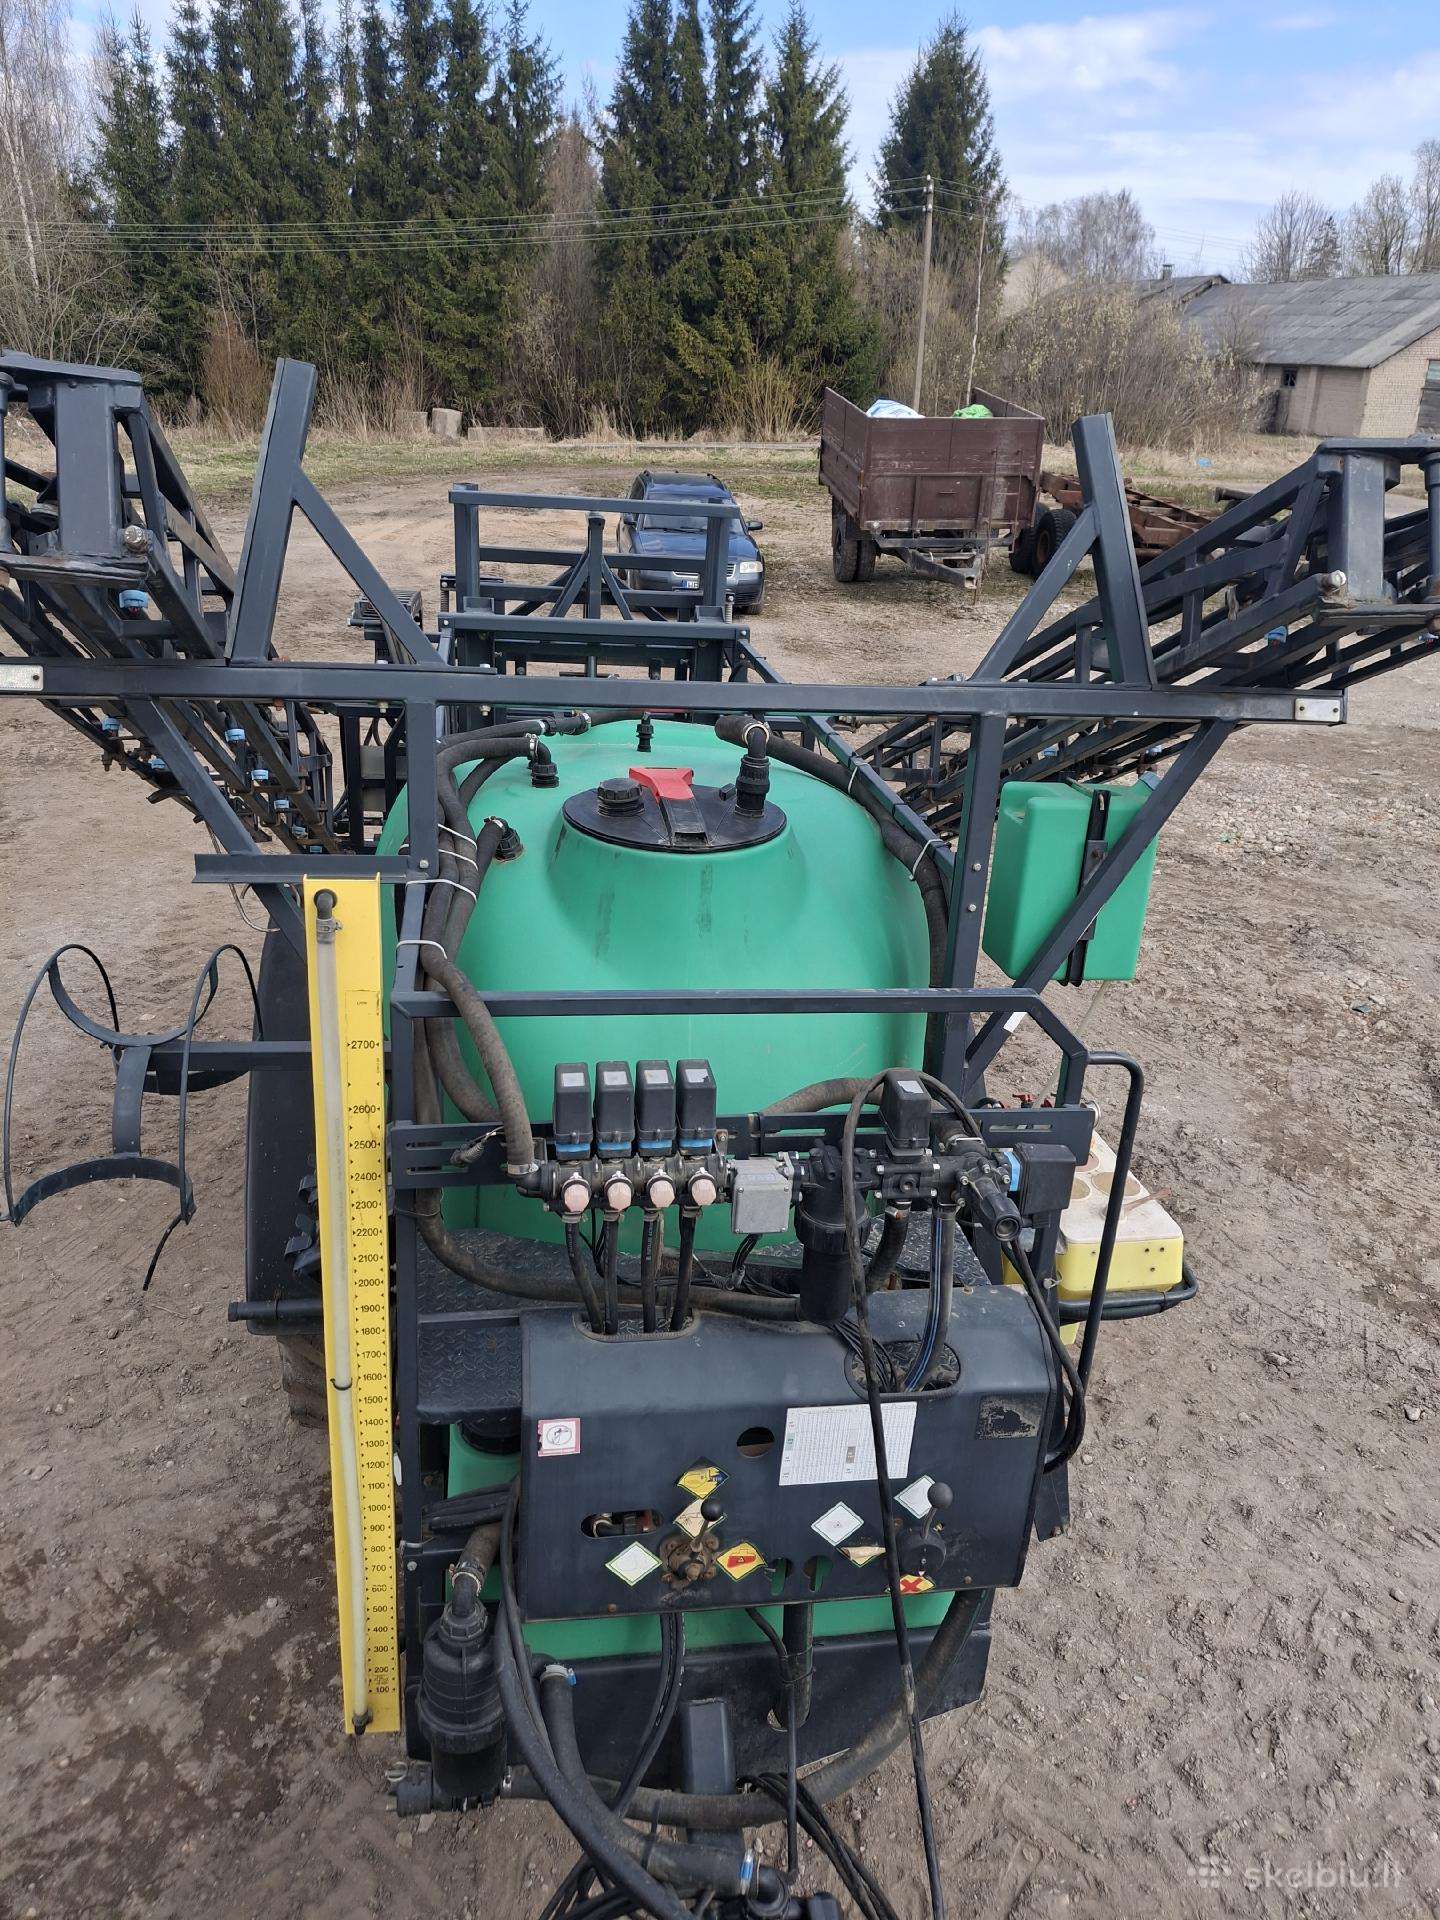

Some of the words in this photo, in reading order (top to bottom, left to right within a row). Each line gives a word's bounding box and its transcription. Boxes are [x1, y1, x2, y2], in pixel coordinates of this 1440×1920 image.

[351, 1040, 375, 1049] 2700
[353, 1104, 376, 1114] 2600
[354, 1140, 377, 1149] 2500
[354, 1172, 377, 1181] 2400
[355, 1200, 378, 1209] 2300
[356, 1227, 379, 1237] 2200
[358, 1254, 379, 1263] 2100
[358, 1278, 380, 1287] 2000
[360, 1304, 381, 1312] 1900
[361, 1327, 381, 1335] 1800
[362, 1350, 381, 1359] 1700
[363, 1372, 382, 1381] 1600
[364, 1395, 383, 1404] 1500
[364, 1418, 384, 1426] 1400
[365, 1439, 385, 1448] 1300
[366, 1460, 386, 1469] 1200
[367, 1482, 385, 1490] 1100
[368, 1504, 387, 1512] 1000
[370, 1524, 385, 1532] 900
[370, 1545, 386, 1553] 800
[371, 1564, 387, 1572] 700
